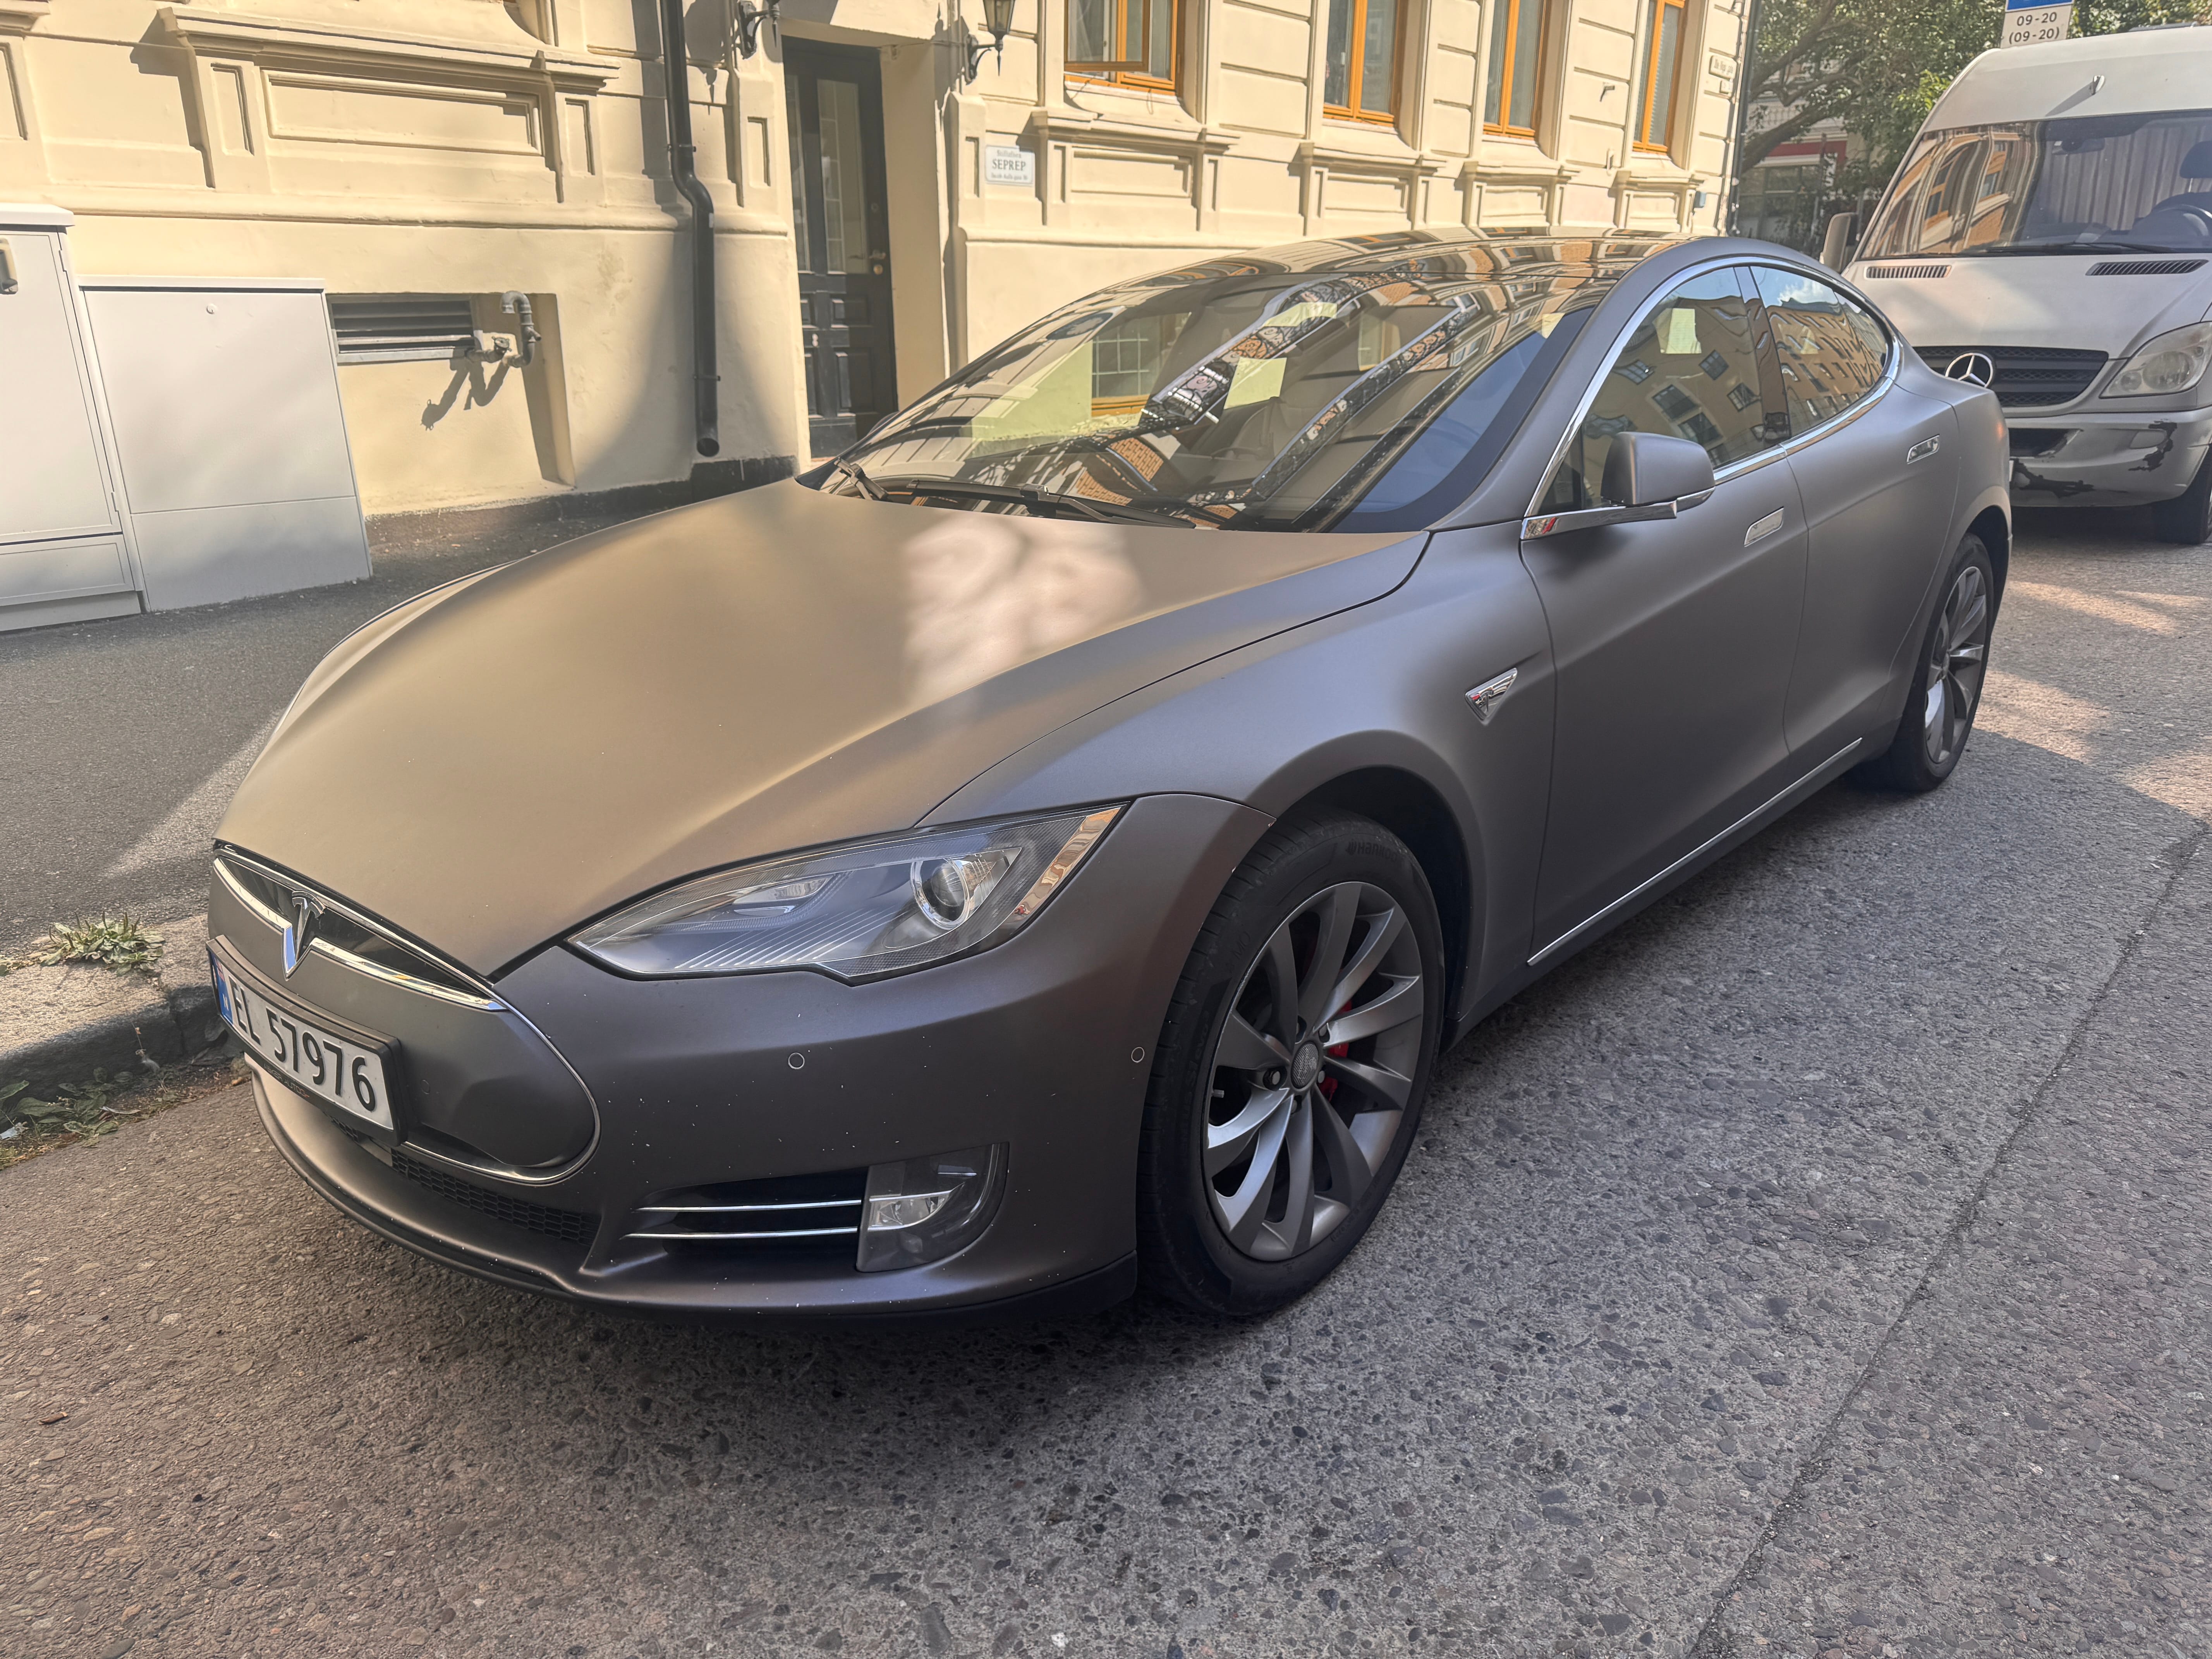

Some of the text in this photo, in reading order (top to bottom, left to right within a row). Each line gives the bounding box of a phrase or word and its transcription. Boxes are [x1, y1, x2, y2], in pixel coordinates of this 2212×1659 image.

[2017, 12, 2057, 26] 09-20
[2009, 27, 2059, 45] (09-20)
[992, 158, 1026, 171] SEPREP
[222, 993, 229, 1011] N
[228, 975, 376, 1112] EL 57976
